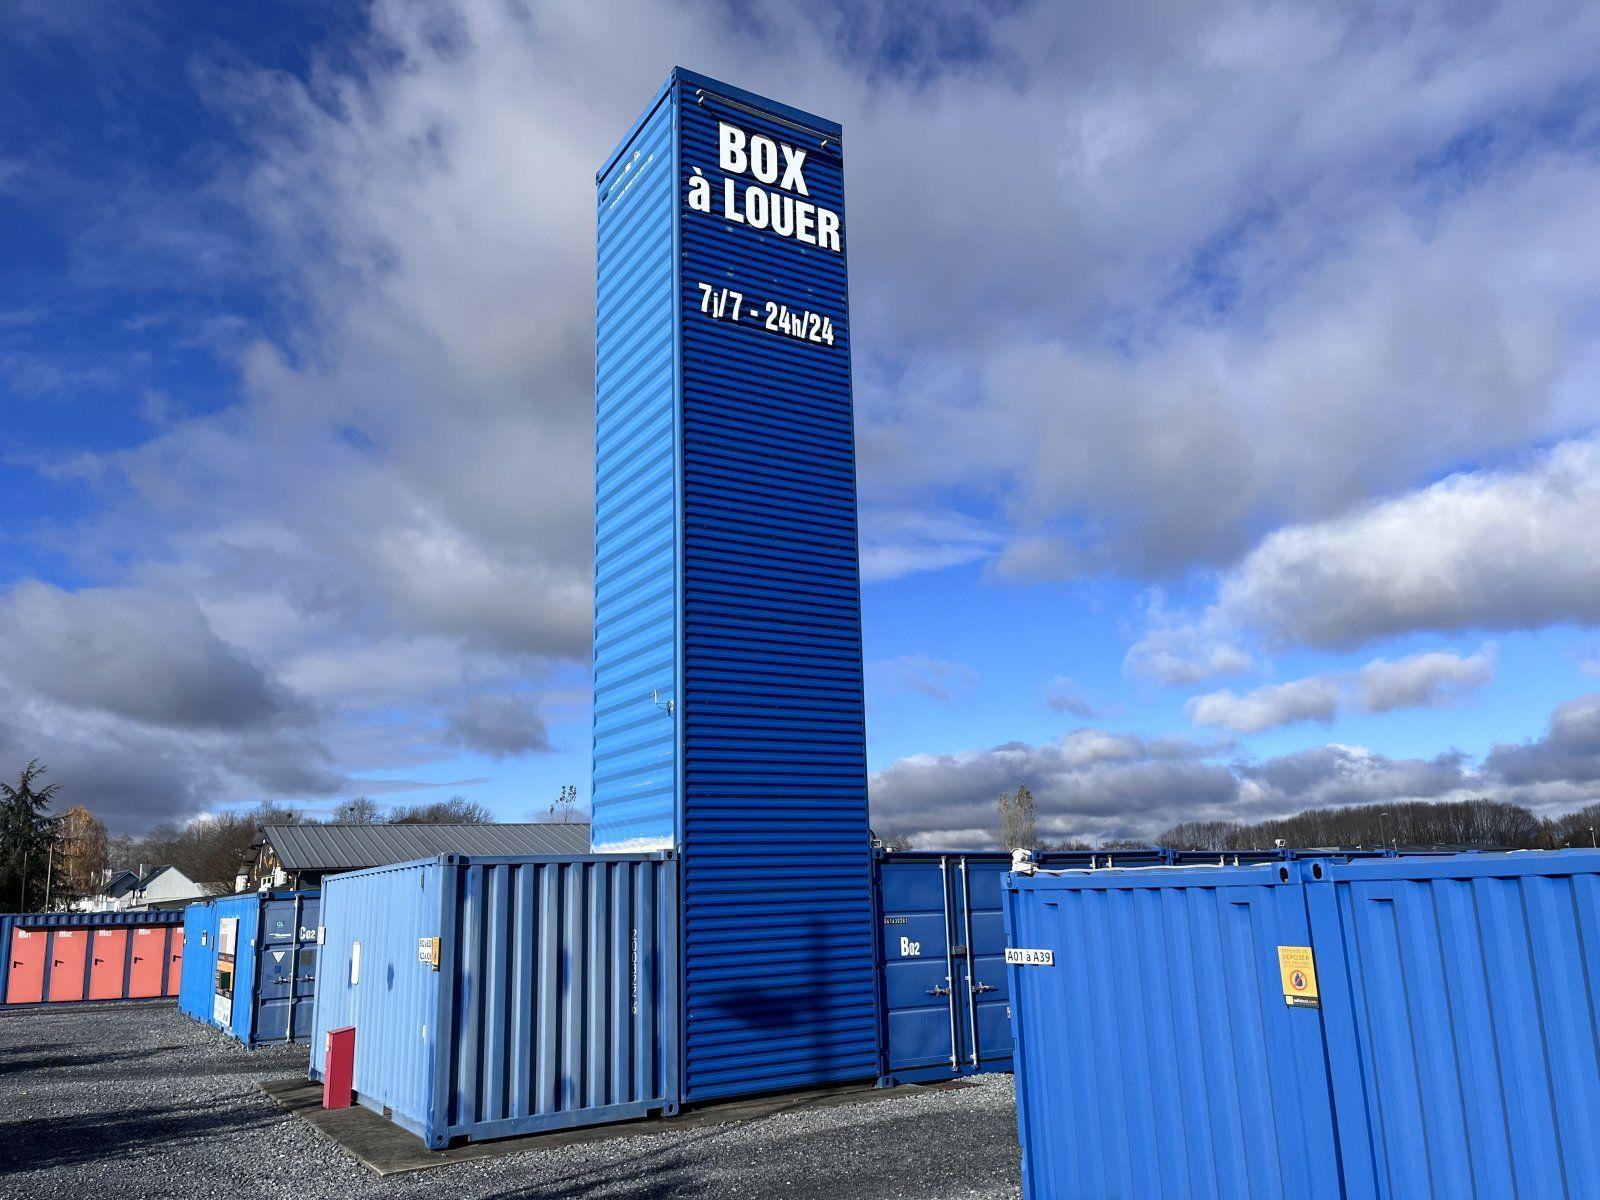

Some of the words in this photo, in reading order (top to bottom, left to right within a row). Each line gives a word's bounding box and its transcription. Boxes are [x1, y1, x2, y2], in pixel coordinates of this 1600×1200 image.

[719, 121, 809, 196] BOX
[688, 166, 710, 213] à
[724, 178, 841, 252] LOUER
[698, 282, 743, 321] 7j/7
[765, 301, 834, 346] 24h/24
[300, 926, 316, 940] C02
[900, 936, 920, 956] B02
[1007, 951, 1023, 961] A01
[1026, 950, 1031, 962] à
[1033, 951, 1051, 962] A39
